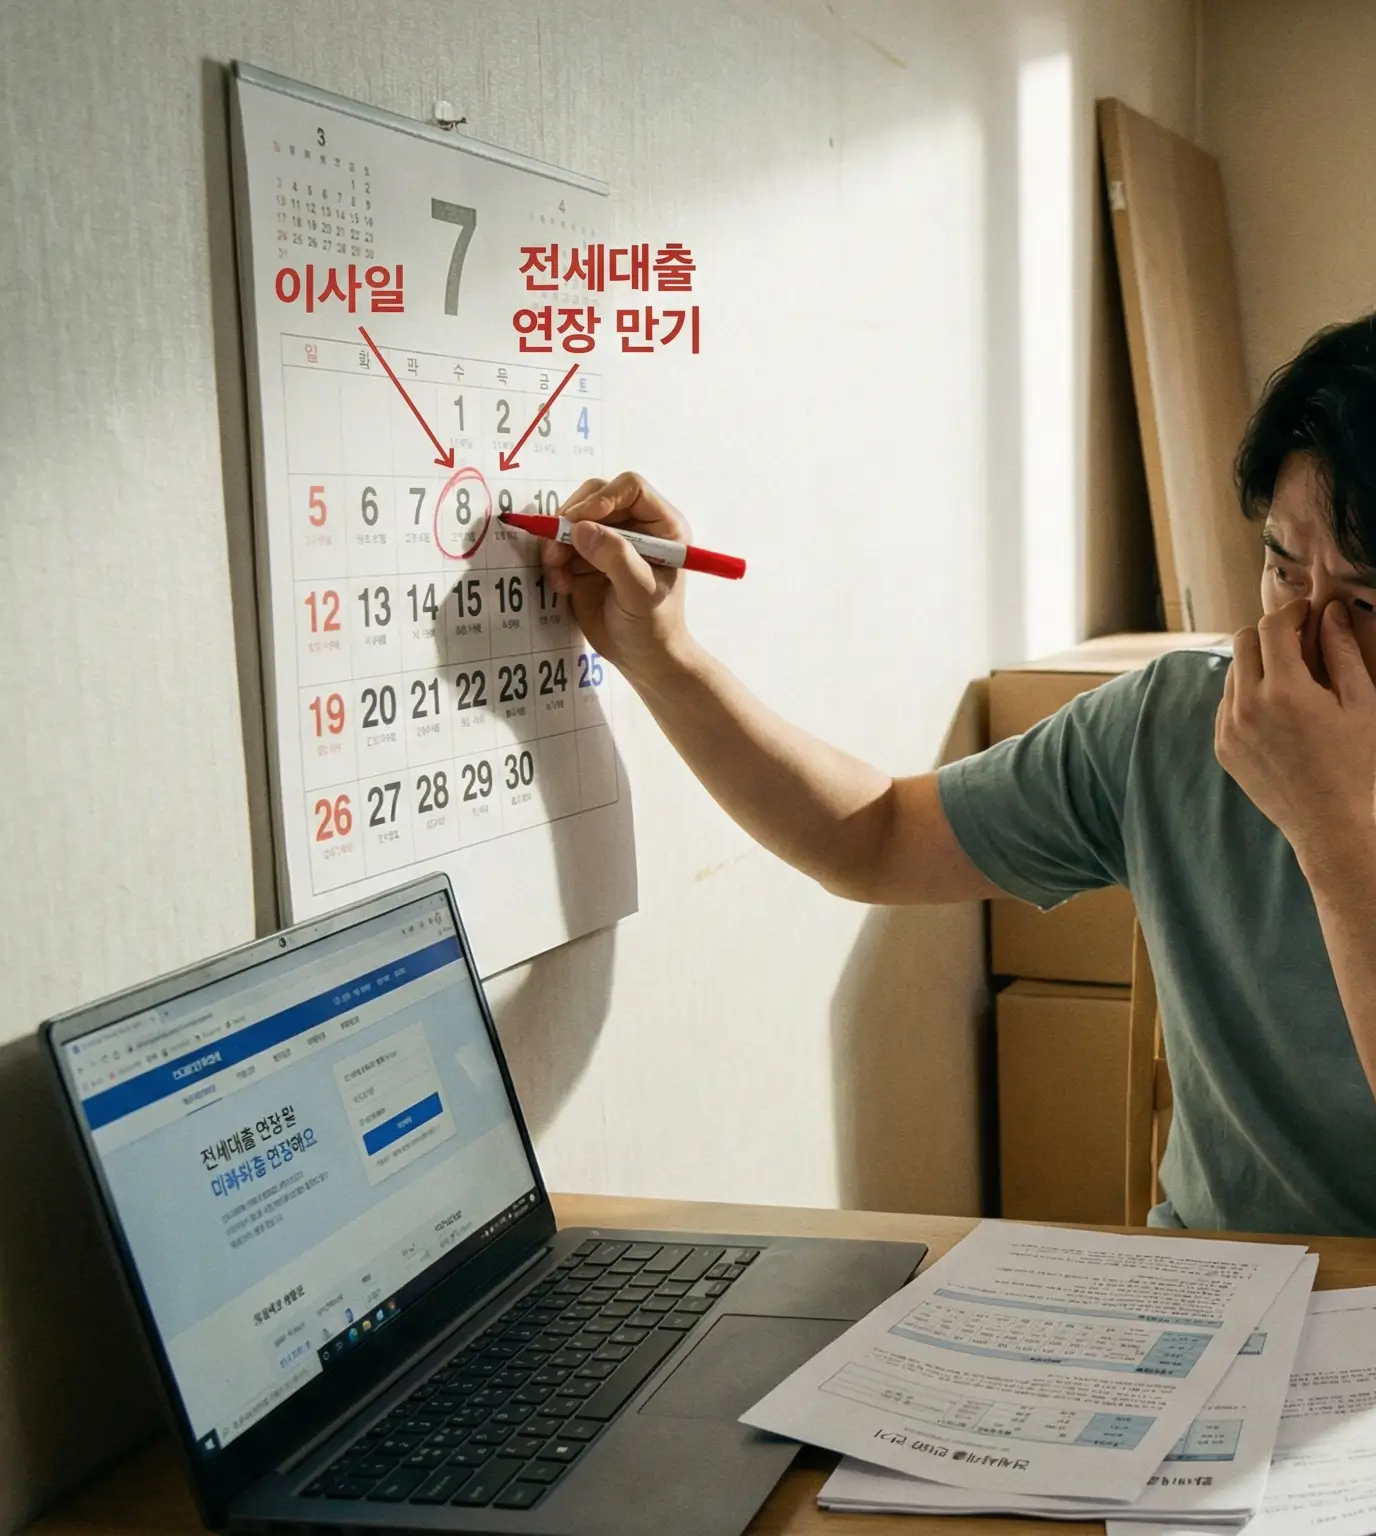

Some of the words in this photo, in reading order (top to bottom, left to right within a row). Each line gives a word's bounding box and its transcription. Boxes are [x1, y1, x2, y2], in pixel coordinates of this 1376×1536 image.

[317, 127, 326, 147] 3
[431, 197, 477, 317] 7
[453, 395, 465, 432] 1
[496, 399, 511, 434] 2
[537, 402, 551, 438] 3
[576, 406, 590, 440] 4
[309, 485, 327, 527] 5
[361, 486, 379, 526] 6
[409, 487, 426, 526] 7
[455, 488, 472, 526] 8
[498, 489, 513, 516] 9
[304, 590, 341, 633] 12
[358, 586, 392, 628] 13
[407, 583, 439, 623] 14
[452, 579, 483, 618] 15
[495, 576, 523, 613] 16
[309, 692, 345, 738] 19
[361, 685, 397, 729] 20
[410, 677, 441, 719] 21
[456, 670, 487, 711] 22
[498, 663, 529, 703] 23
[538, 658, 568, 696] 24
[577, 653, 604, 689] 25
[314, 794, 353, 842] 26
[367, 781, 401, 828] 27
[416, 771, 449, 813] 28
[461, 759, 493, 802] 29
[504, 750, 534, 790] 30
